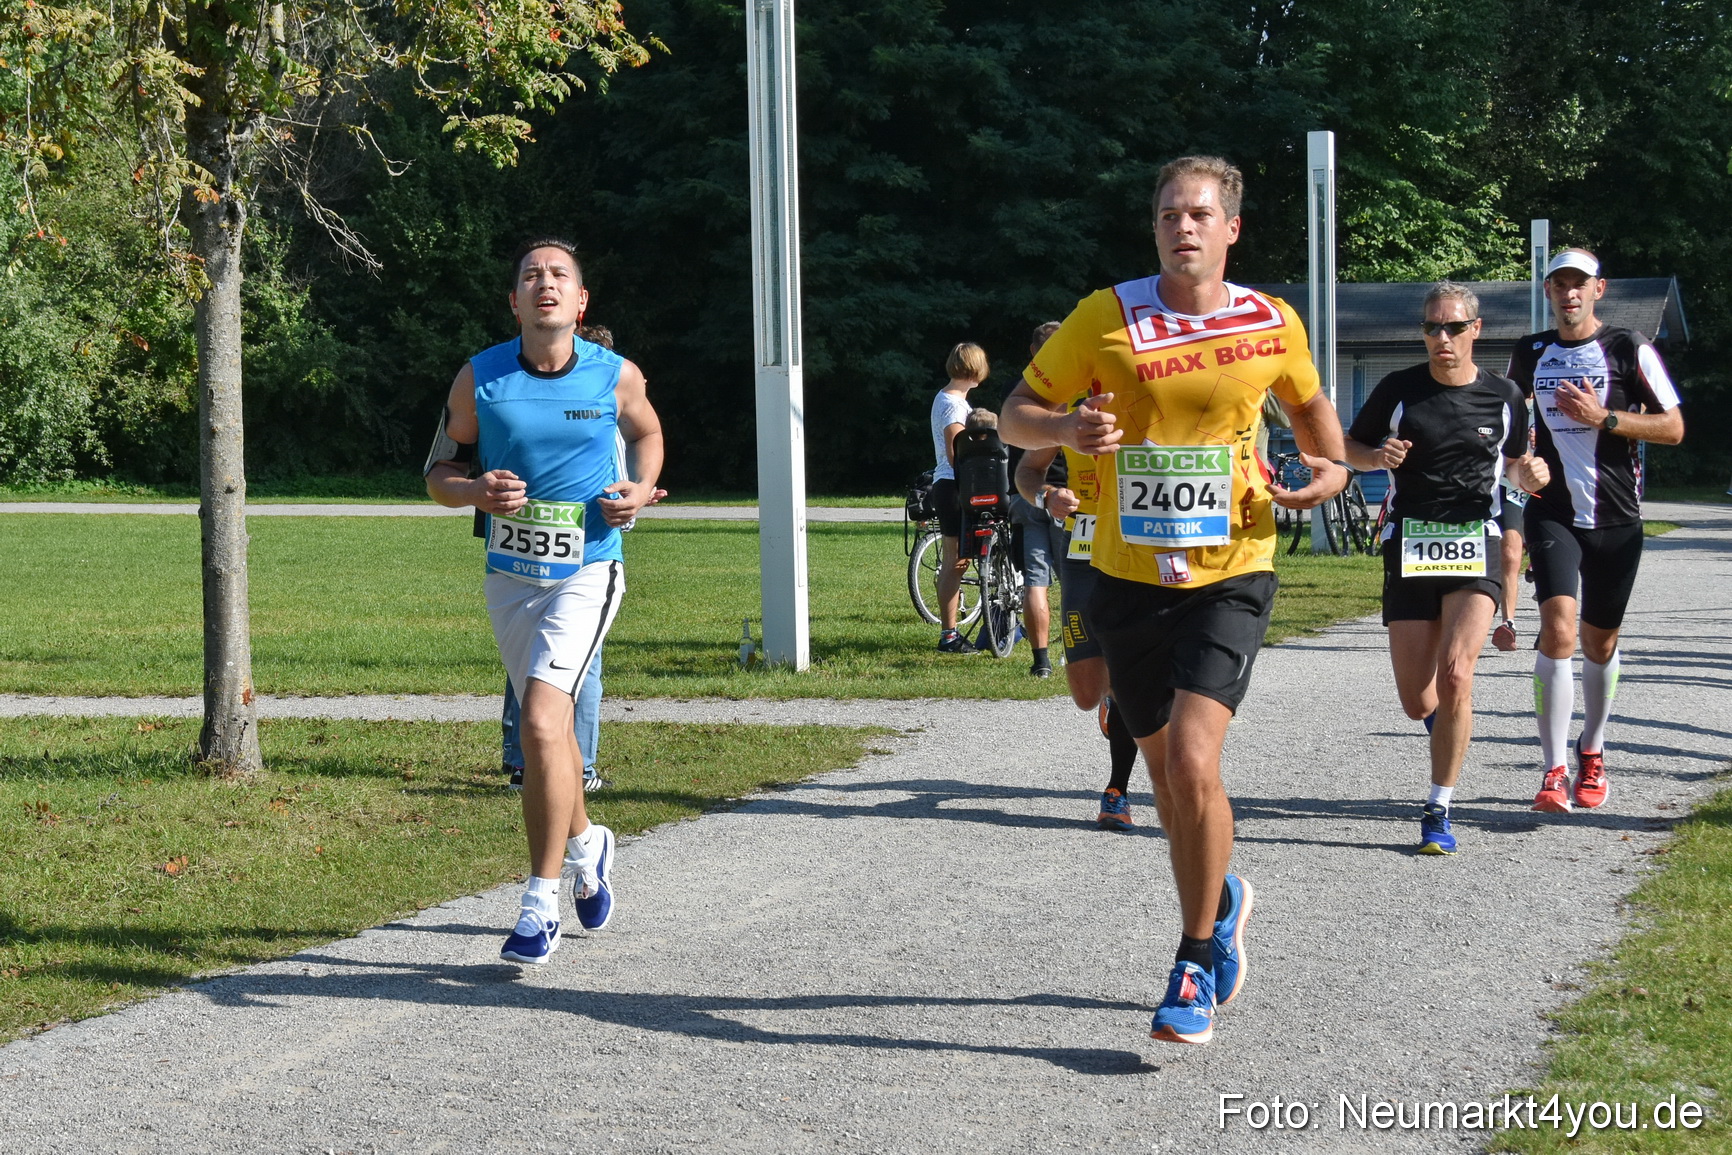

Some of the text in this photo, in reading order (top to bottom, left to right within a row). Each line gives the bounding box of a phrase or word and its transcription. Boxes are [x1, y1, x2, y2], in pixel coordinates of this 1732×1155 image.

[1136, 338, 1287, 383] MAX BÖGL
[1125, 452, 1221, 471] BOCK
[1131, 481, 1217, 511] 2404
[513, 503, 576, 524] OCK
[1143, 521, 1203, 535] PATRIK
[1410, 521, 1476, 535] BOCK
[499, 524, 571, 558] 2535
[1413, 541, 1476, 561] 1088
[512, 560, 551, 577] SVEN
[1069, 614, 1085, 639] Run!
